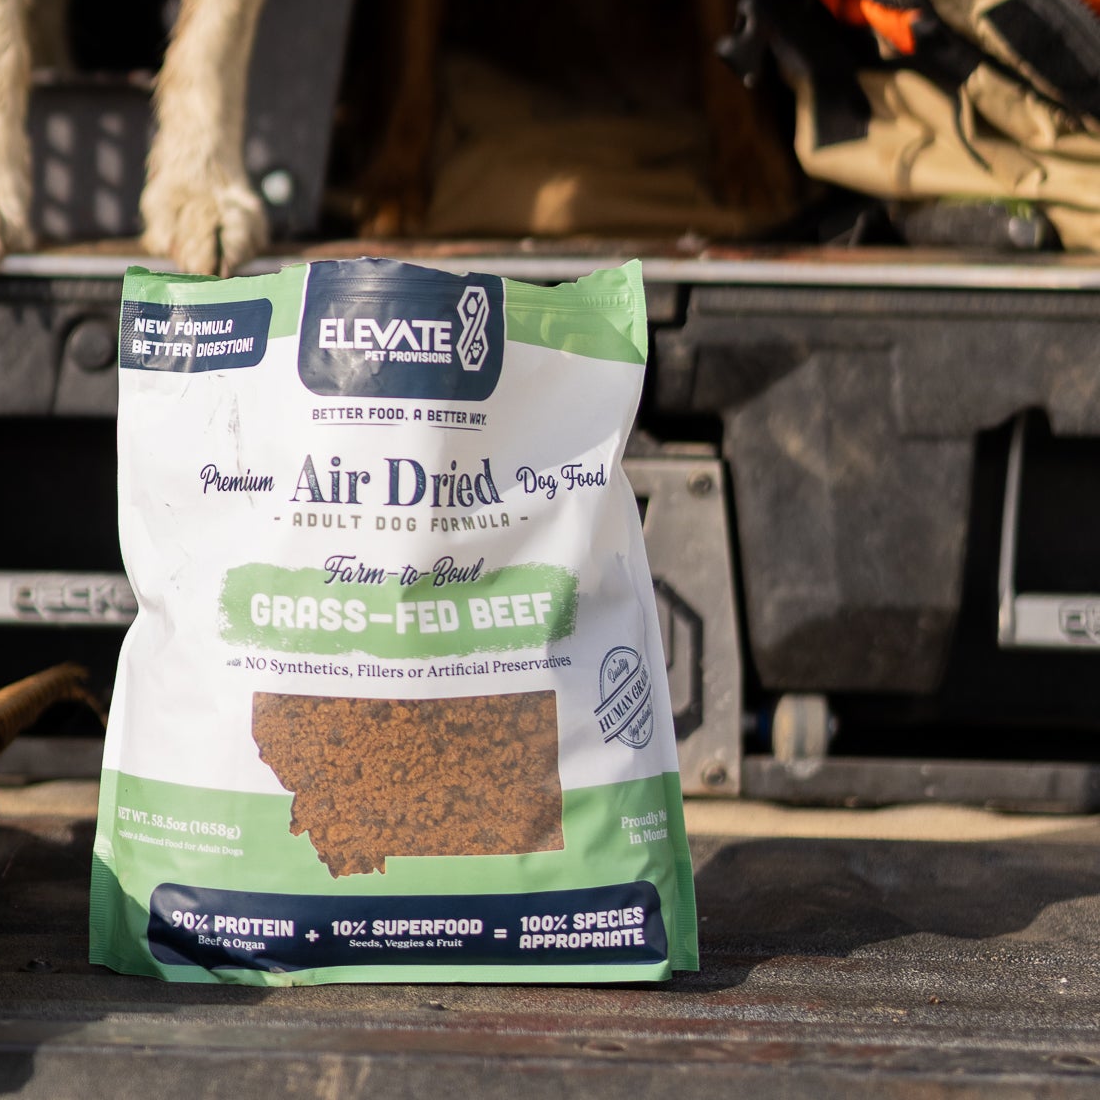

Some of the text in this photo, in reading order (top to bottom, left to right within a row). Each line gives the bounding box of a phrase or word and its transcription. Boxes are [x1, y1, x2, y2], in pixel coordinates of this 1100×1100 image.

[134, 317, 233, 336] NEW FORMULA
[318, 318, 452, 352] ELEVATE
[131, 337, 254, 358] BETTER DIGESTION!
[364, 351, 452, 364] PET PROVISIONS
[312, 407, 363, 421] BETTER
[413, 409, 422, 421] A
[427, 409, 467, 424] BETTER
[469, 412, 487, 426] WAY.
[200, 454, 606, 508] Premium Air Dried Dog Food
[293, 512, 510, 532] ADULT DOG FORMULA
[467, 592, 552, 630] BEEF
[245, 656, 267, 671] NO
[270, 659, 353, 677] Synthetics,
[357, 664, 404, 678] Fillers
[408, 668, 424, 678] or
[427, 661, 490, 678] Artificial
[493, 655, 572, 673] Preservatives
[598, 691, 634, 733] HUMAN
[131, 809, 151, 825] WT.
[151, 814, 188, 832] 58.5oz
[189, 820, 242, 840] (1658g)
[621, 811, 658, 829] Proudly
[629, 831, 642, 845] in
[171, 910, 209, 930] 90%
[214, 915, 295, 936] PROTEIN
[331, 920, 367, 936] 10%
[372, 918, 483, 936] SUPERFOOD
[520, 914, 568, 932] 100%
[572, 906, 645, 930] SPECIES
[198, 934, 266, 950] Beef & Organ
[349, 938, 463, 949] Seeds, Veggies & Fruit
[519, 928, 646, 949] APPROPRIATE
